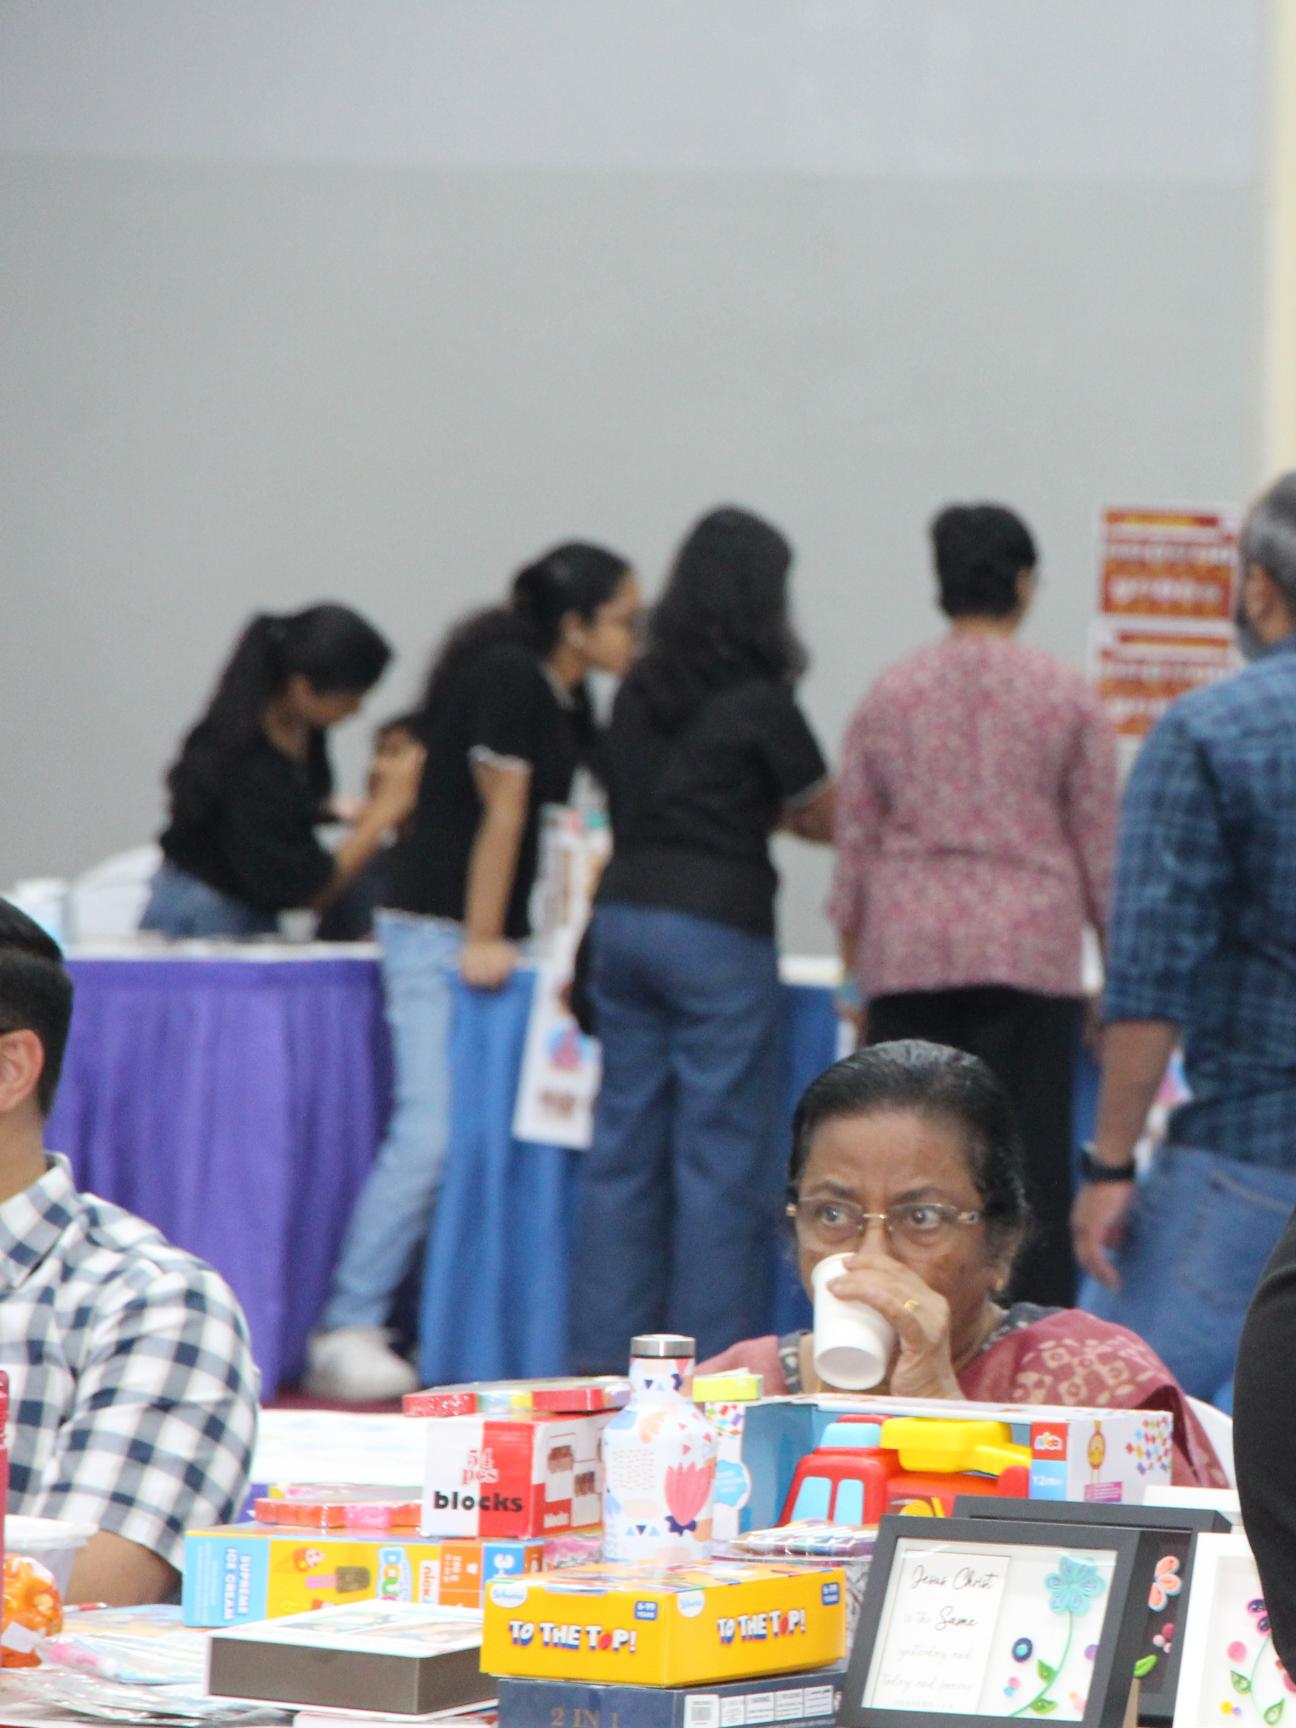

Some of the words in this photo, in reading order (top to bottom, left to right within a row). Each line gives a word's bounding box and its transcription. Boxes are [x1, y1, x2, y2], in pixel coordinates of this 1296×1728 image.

[433, 1490, 523, 1513] blocks
[381, 1549, 402, 1600] DOU
[911, 1564, 948, 1590] Jesus
[953, 1566, 1000, 1591] Christ
[717, 1618, 736, 1646] TO
[738, 1613, 767, 1641] THE
[934, 1604, 978, 1631] Same
[509, 1620, 535, 1646] TO
[540, 1622, 582, 1650] THE
[550, 1706, 565, 1727] 2
[573, 1708, 599, 1728] IN
